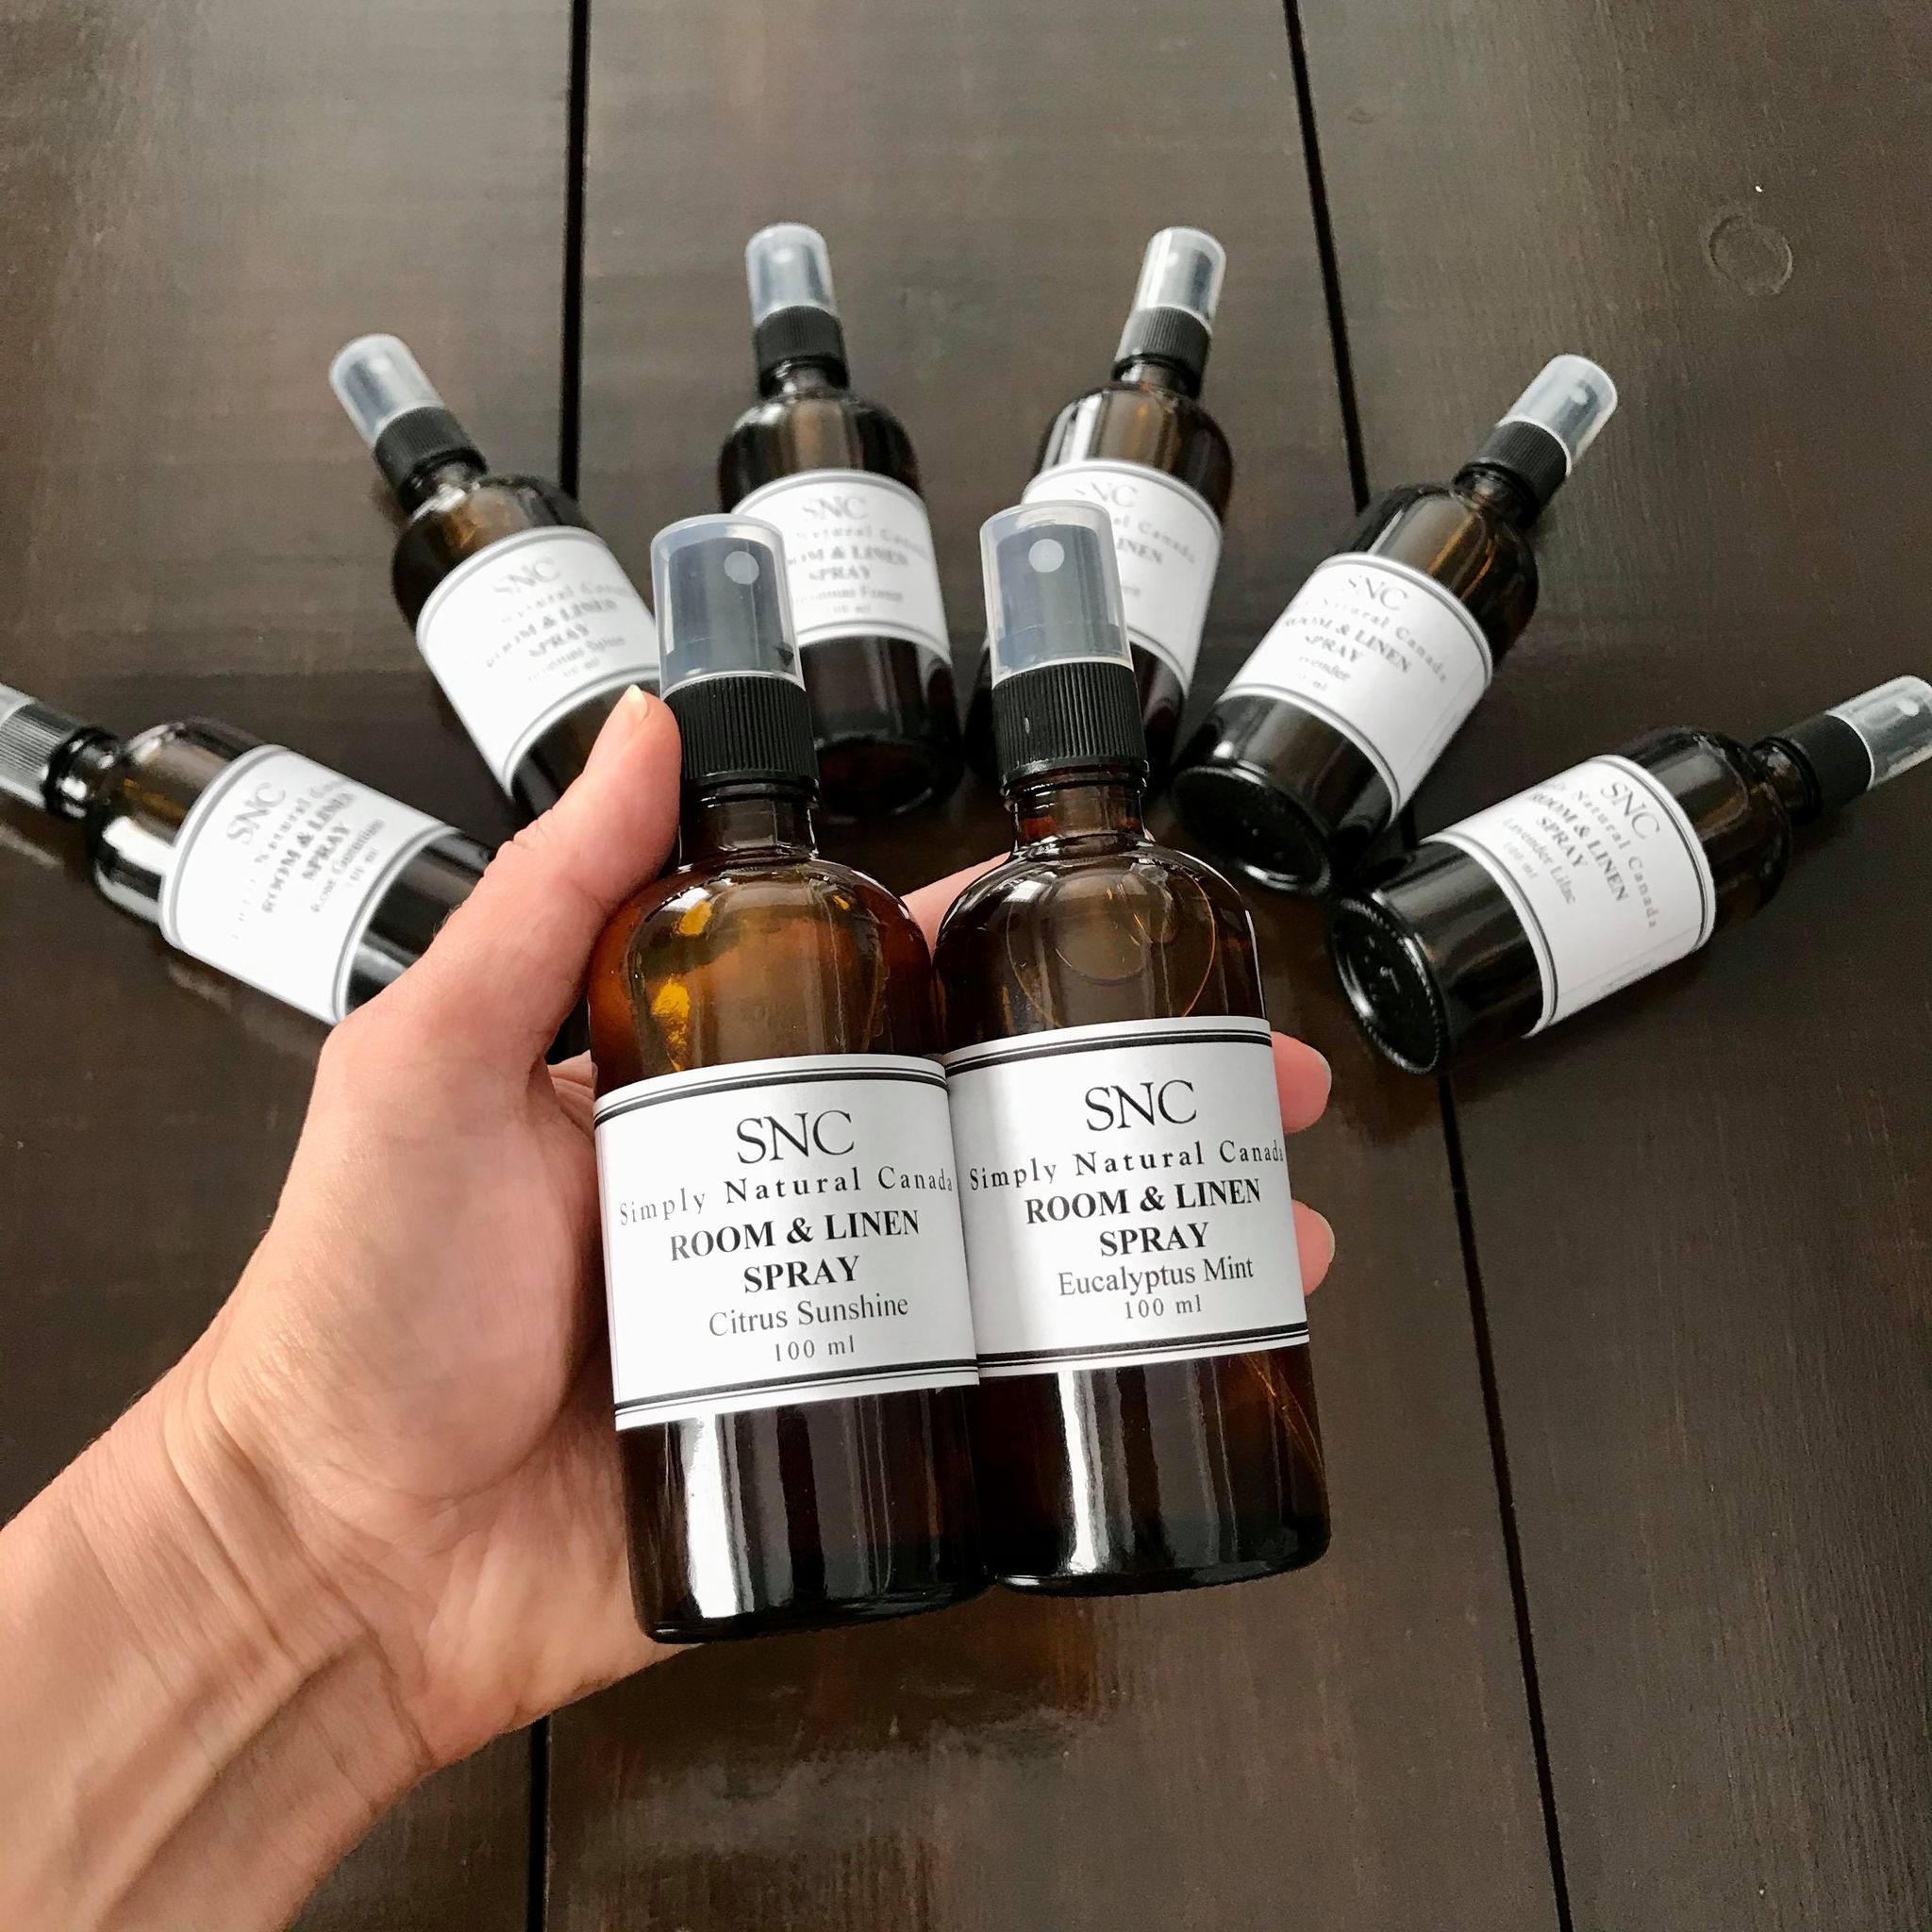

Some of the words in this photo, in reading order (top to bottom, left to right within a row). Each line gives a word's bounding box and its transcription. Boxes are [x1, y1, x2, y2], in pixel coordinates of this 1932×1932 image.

[1118, 537, 1163, 564] INEN
[1323, 597, 1391, 629] ural
[1355, 628, 1412, 673] LINEN
[226, 781, 287, 845] SNC
[1601, 782, 1659, 839] SNC
[1536, 817, 1590, 867] SPRAY
[1574, 824, 1591, 839] &
[1588, 840, 1629, 901] LINEN
[1628, 856, 1659, 928] Canada
[1085, 1079, 1196, 1131] SNC
[737, 1110, 854, 1164] SNC
[970, 1158, 1058, 1191] Simply
[1073, 1141, 1205, 1176] Natural
[1219, 1140, 1284, 1164] Canada
[620, 1188, 705, 1225] Simply
[724, 1166, 861, 1204] Natural
[877, 1166, 954, 1192] Canada
[1024, 1189, 1130, 1224] ROOM
[1140, 1186, 1166, 1212] &
[1174, 1177, 1260, 1209] LINEN
[671, 1221, 776, 1261] ROOM
[787, 1217, 814, 1245] &
[823, 1209, 919, 1241] LINEN
[1099, 1222, 1209, 1257] SPRAY
[744, 1256, 860, 1293] SPRAY
[1058, 1264, 1195, 1296] Eucalyptus
[1201, 1256, 1254, 1282] Mint
[709, 1309, 788, 1336] Citrus
[797, 1292, 908, 1325] Sunshine
[1124, 1298, 1164, 1319] 100
[1175, 1294, 1202, 1314] ml
[775, 1340, 815, 1362] 100
[828, 1335, 855, 1356] ml
